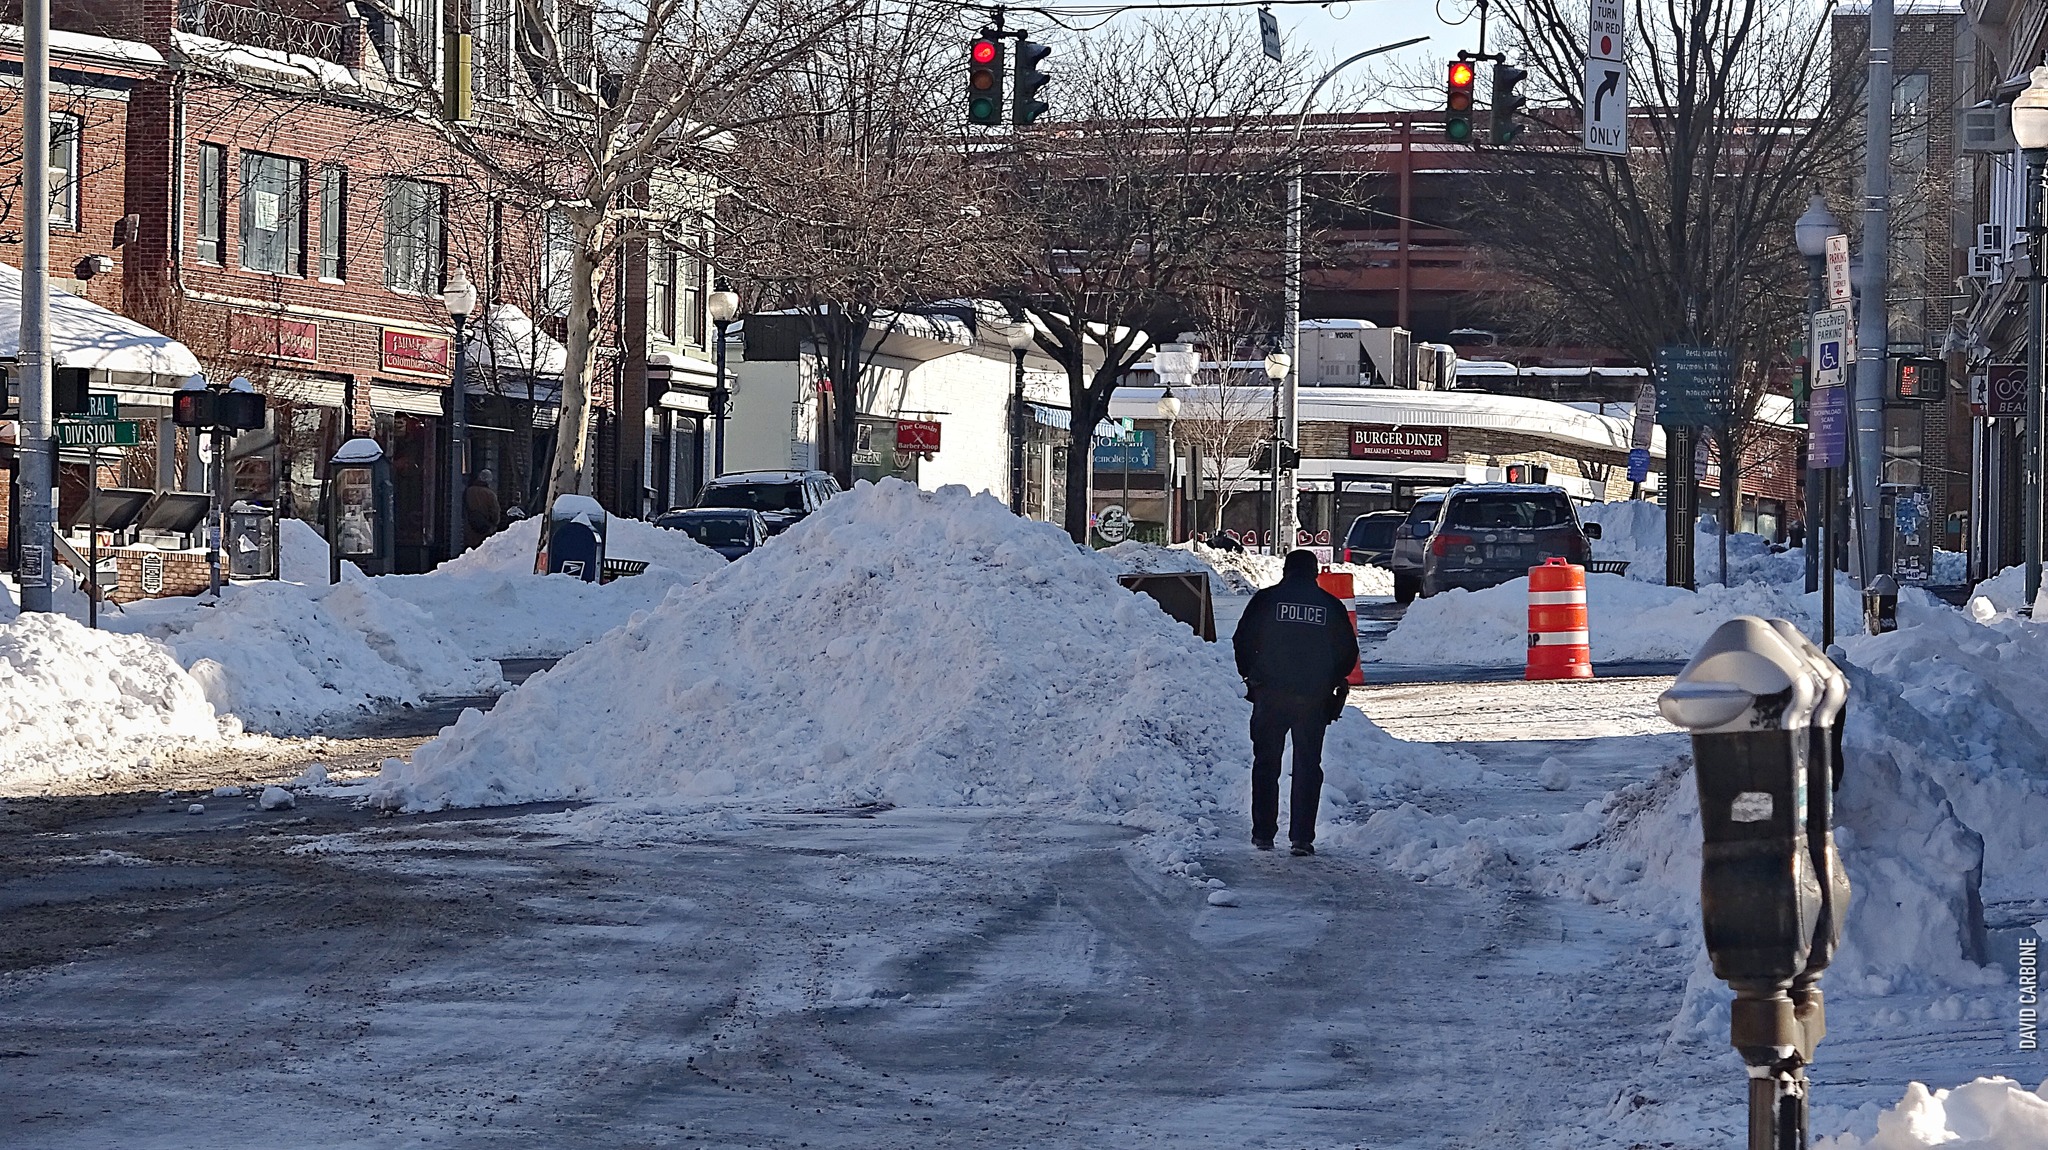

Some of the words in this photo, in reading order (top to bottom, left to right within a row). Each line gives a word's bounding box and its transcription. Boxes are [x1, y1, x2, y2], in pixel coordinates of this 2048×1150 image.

[1598, 6, 1617, 20] TURN
[1593, 20, 1603, 32] ON
[1605, 22, 1620, 35] RED
[1590, 126, 1620, 146] ONLY
[1833, 240, 1841, 251] NO
[1829, 252, 1847, 264] PARKING
[1815, 315, 1845, 328] RESERVED
[1817, 328, 1842, 340] PARKING
[65, 424, 115, 444] DIVISION
[900, 424, 913, 432] The
[914, 423, 938, 433] Cousin
[1355, 431, 1403, 445] BURGER
[1406, 433, 1442, 446] DINER
[921, 443, 939, 451] Shop
[1281, 605, 1323, 622] POLICE
